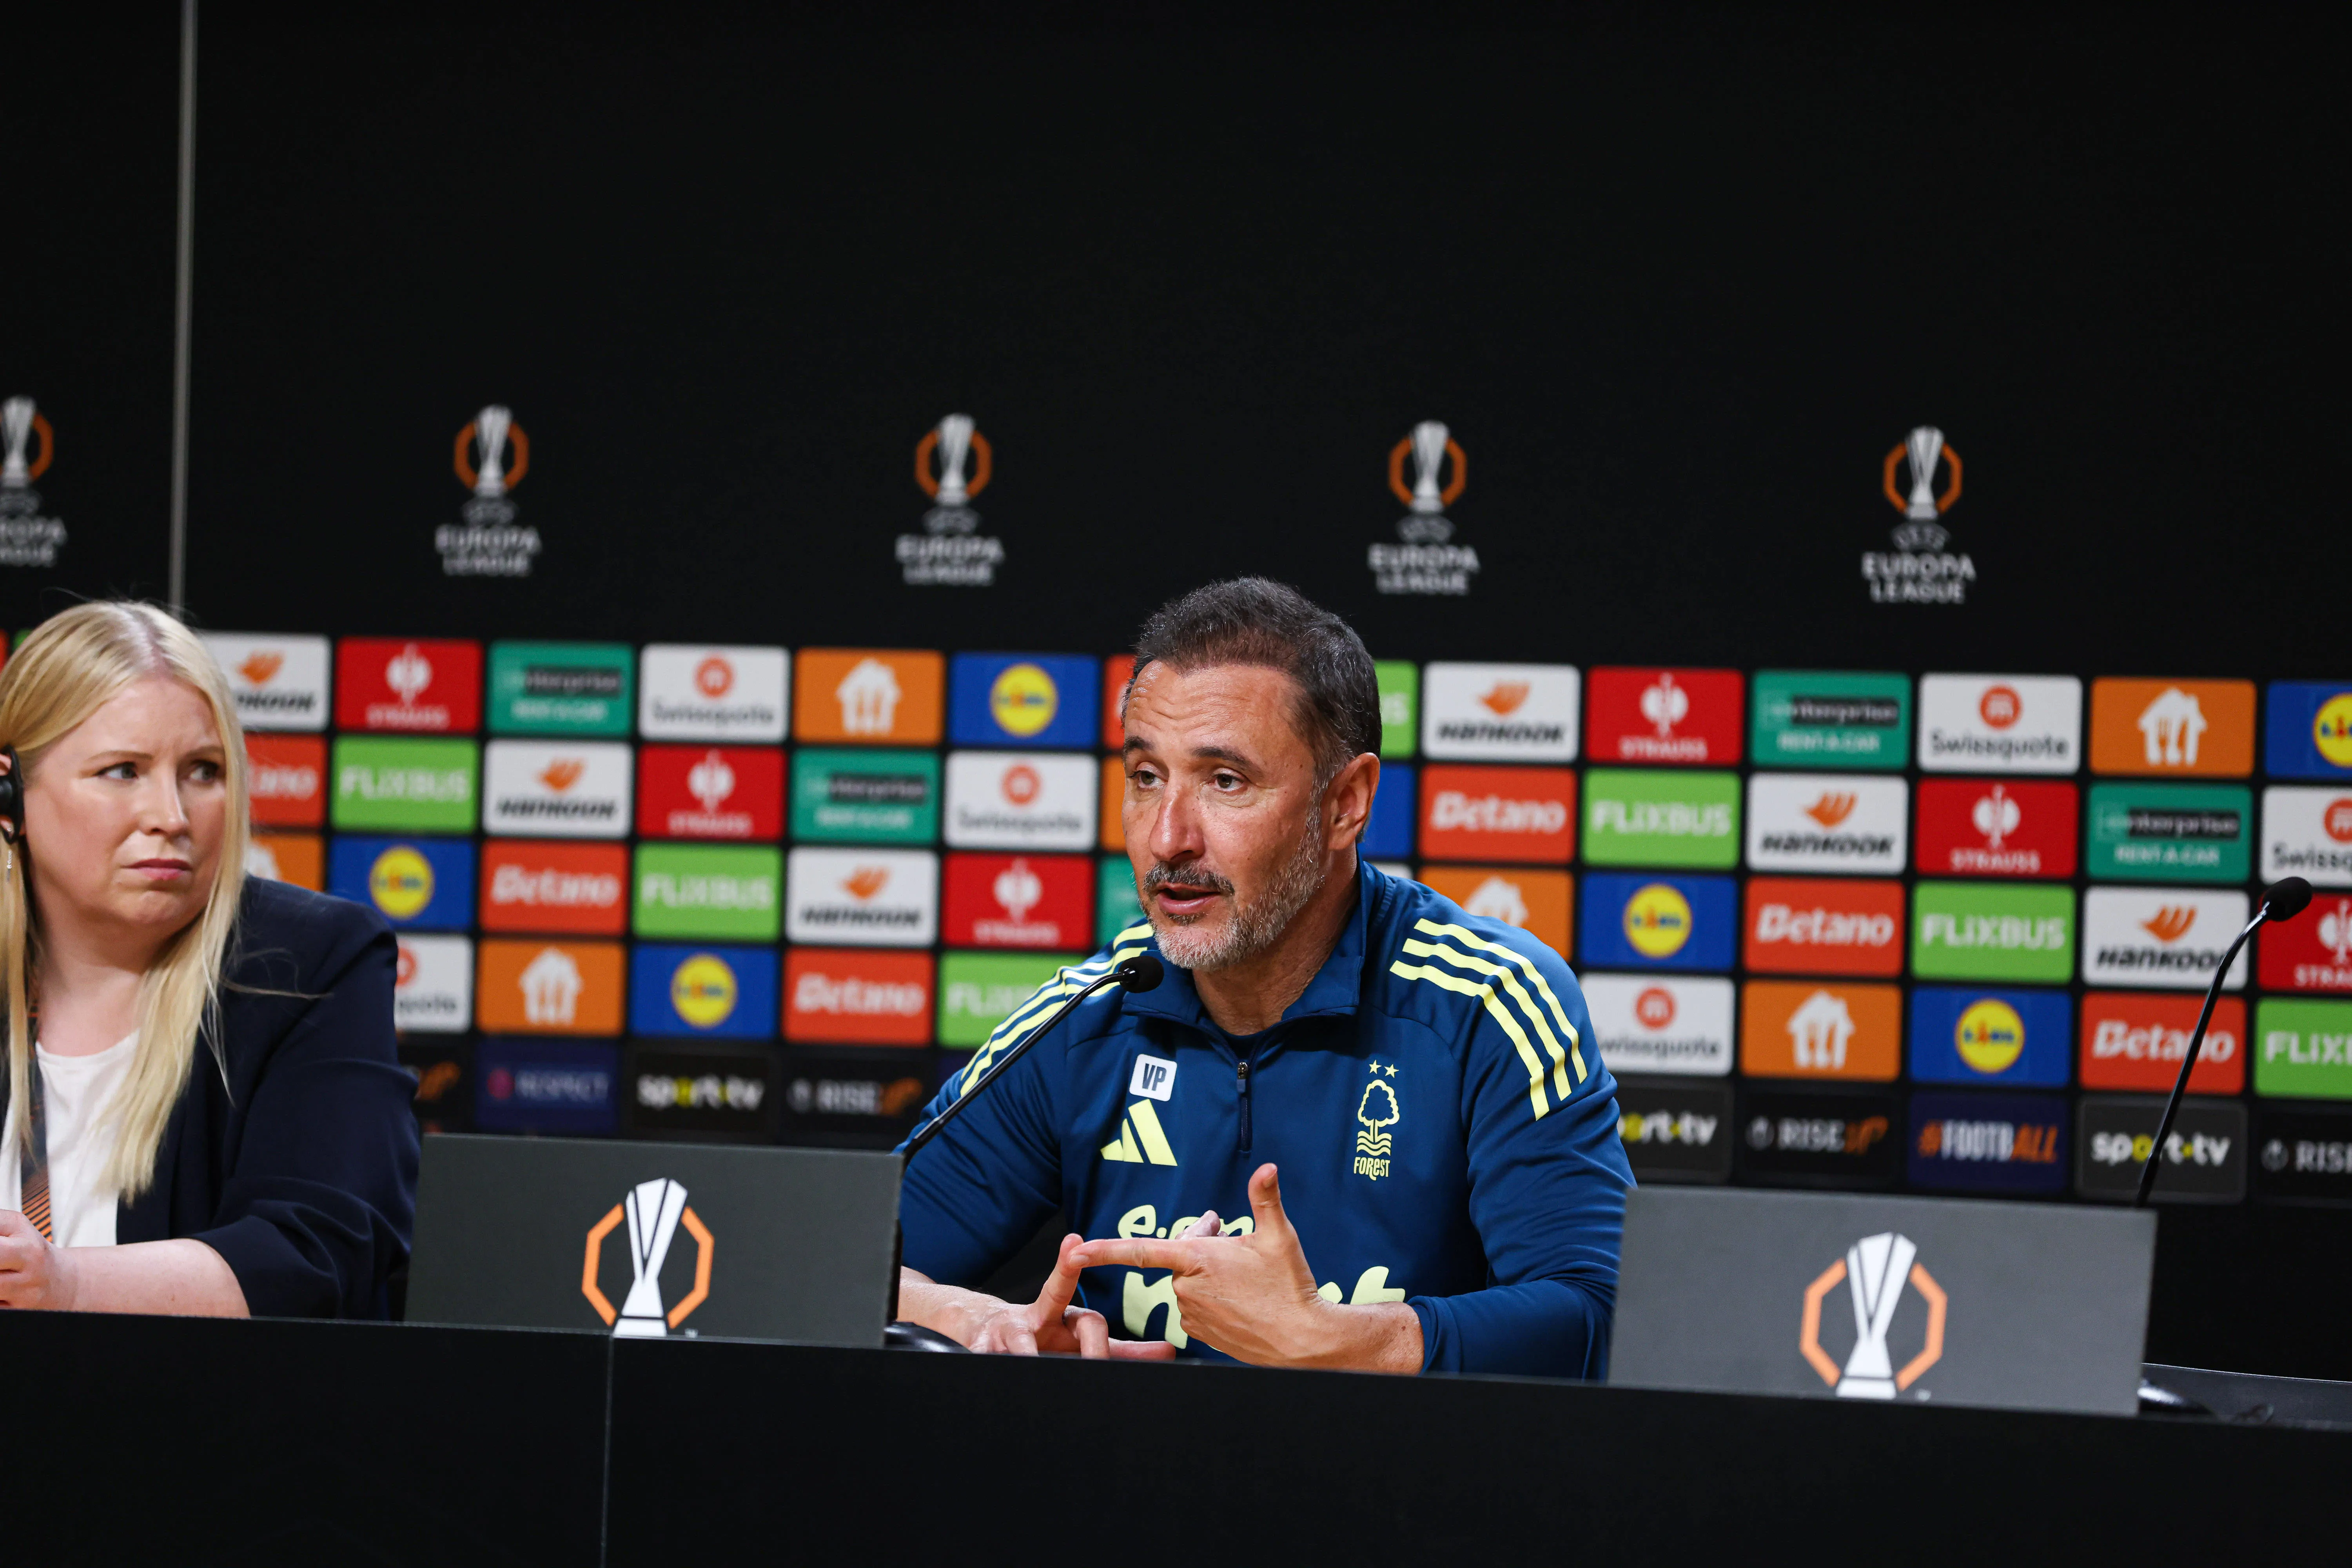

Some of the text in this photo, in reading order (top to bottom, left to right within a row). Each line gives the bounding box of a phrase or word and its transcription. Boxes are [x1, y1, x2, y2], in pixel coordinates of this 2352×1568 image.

[435, 525, 541, 552] EUROPA
[895, 535, 1005, 563] EUROPA
[443, 552, 532, 575] LEAGUE
[1368, 544, 1480, 573] EUROPA
[1862, 552, 1976, 581] EUROPA
[903, 564, 992, 584] LEAGUE
[1377, 573, 1467, 594] LEAGUE
[1870, 581, 1964, 603] LEAGUE
[365, 705, 449, 730] STRAUSS
[1618, 737, 1708, 761] STRAUSS
[1931, 728, 2069, 760] Swissquote
[668, 811, 752, 836] STRAUSS
[1431, 791, 1566, 833] Betano
[1951, 849, 2040, 871] STRAUSS
[491, 864, 620, 906] Betano
[971, 921, 1061, 943] STRAUSS
[1755, 904, 1894, 945] Betano
[2295, 964, 2352, 987] STRA
[796, 973, 927, 1016] Betano
[1599, 1035, 1721, 1060] wissquote
[2265, 1031, 2352, 1064] FLIX
[1142, 1063, 1167, 1091] VP
